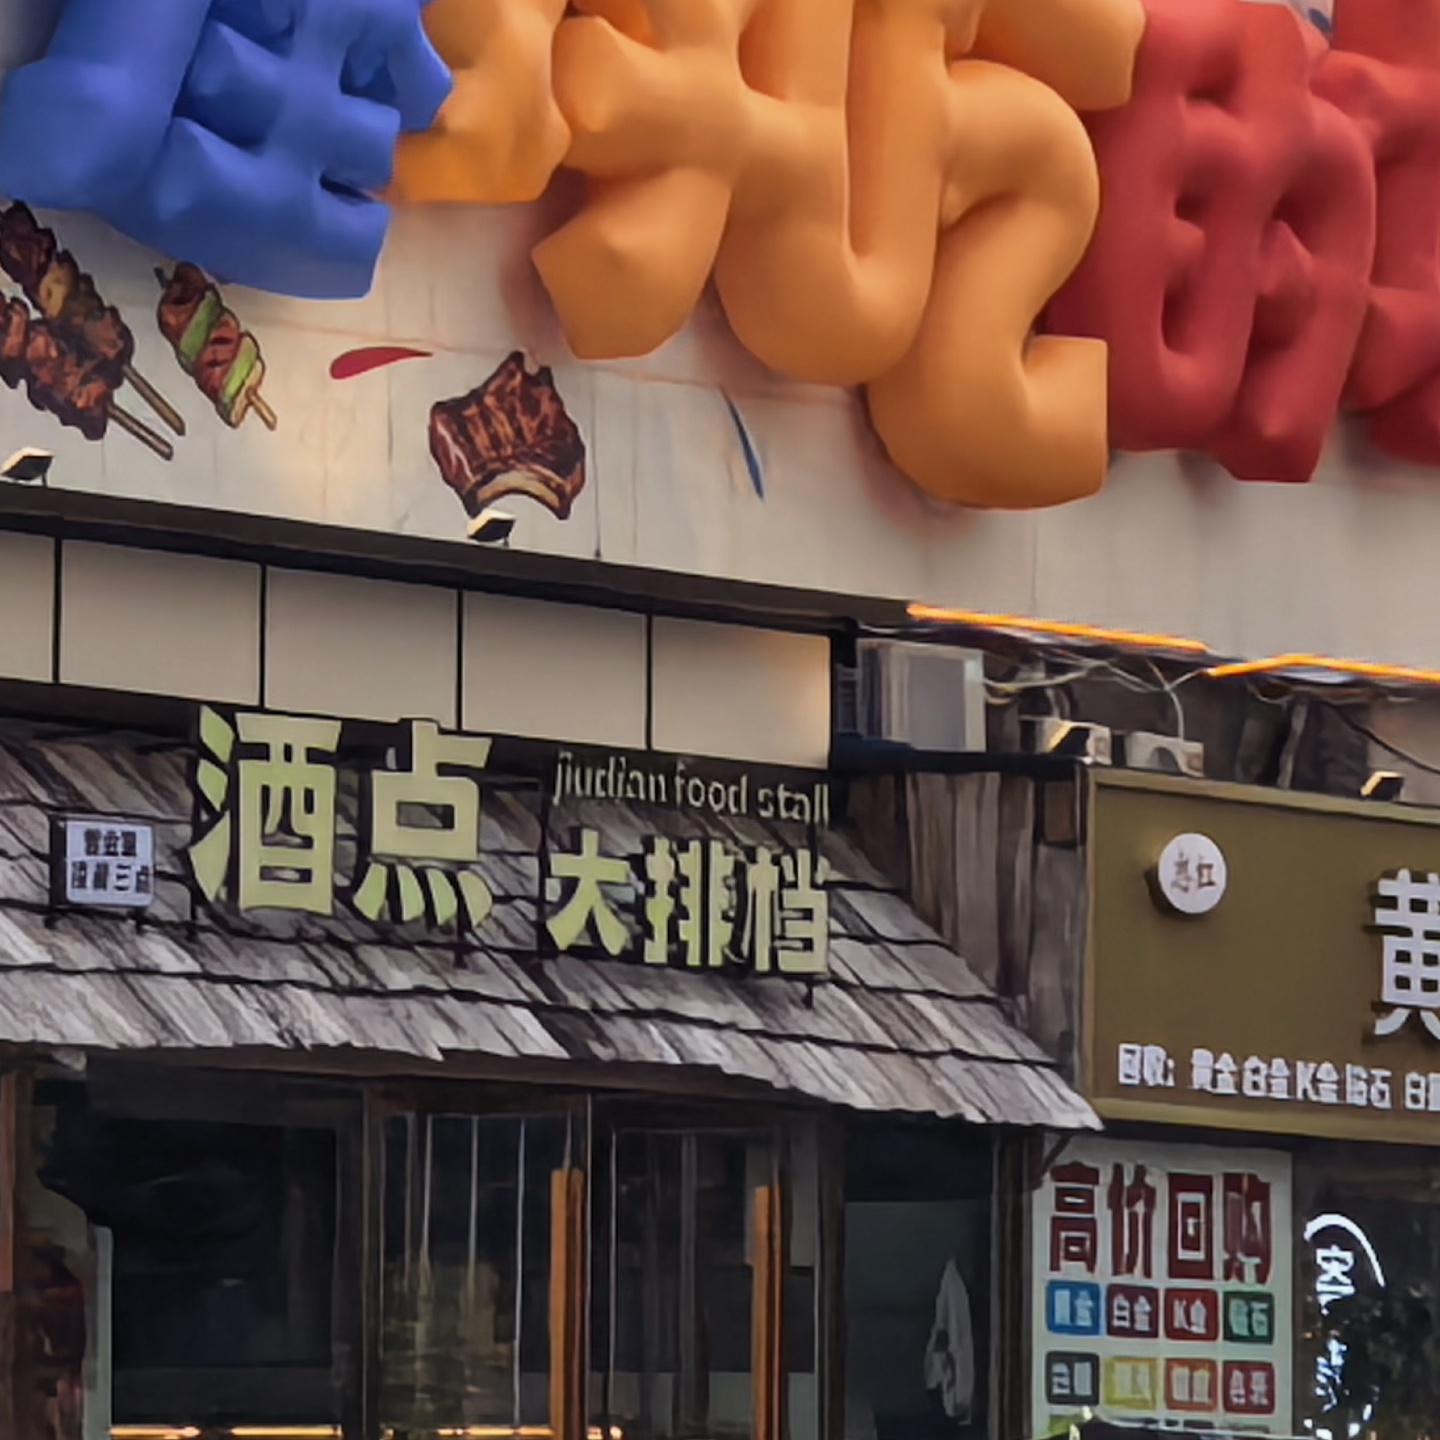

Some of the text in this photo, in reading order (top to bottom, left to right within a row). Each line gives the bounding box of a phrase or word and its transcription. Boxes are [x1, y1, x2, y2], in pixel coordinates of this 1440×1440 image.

[189, 704, 492, 931] 酒点
[552, 751, 830, 827] jiudian food stall
[546, 827, 830, 973] 大排档
